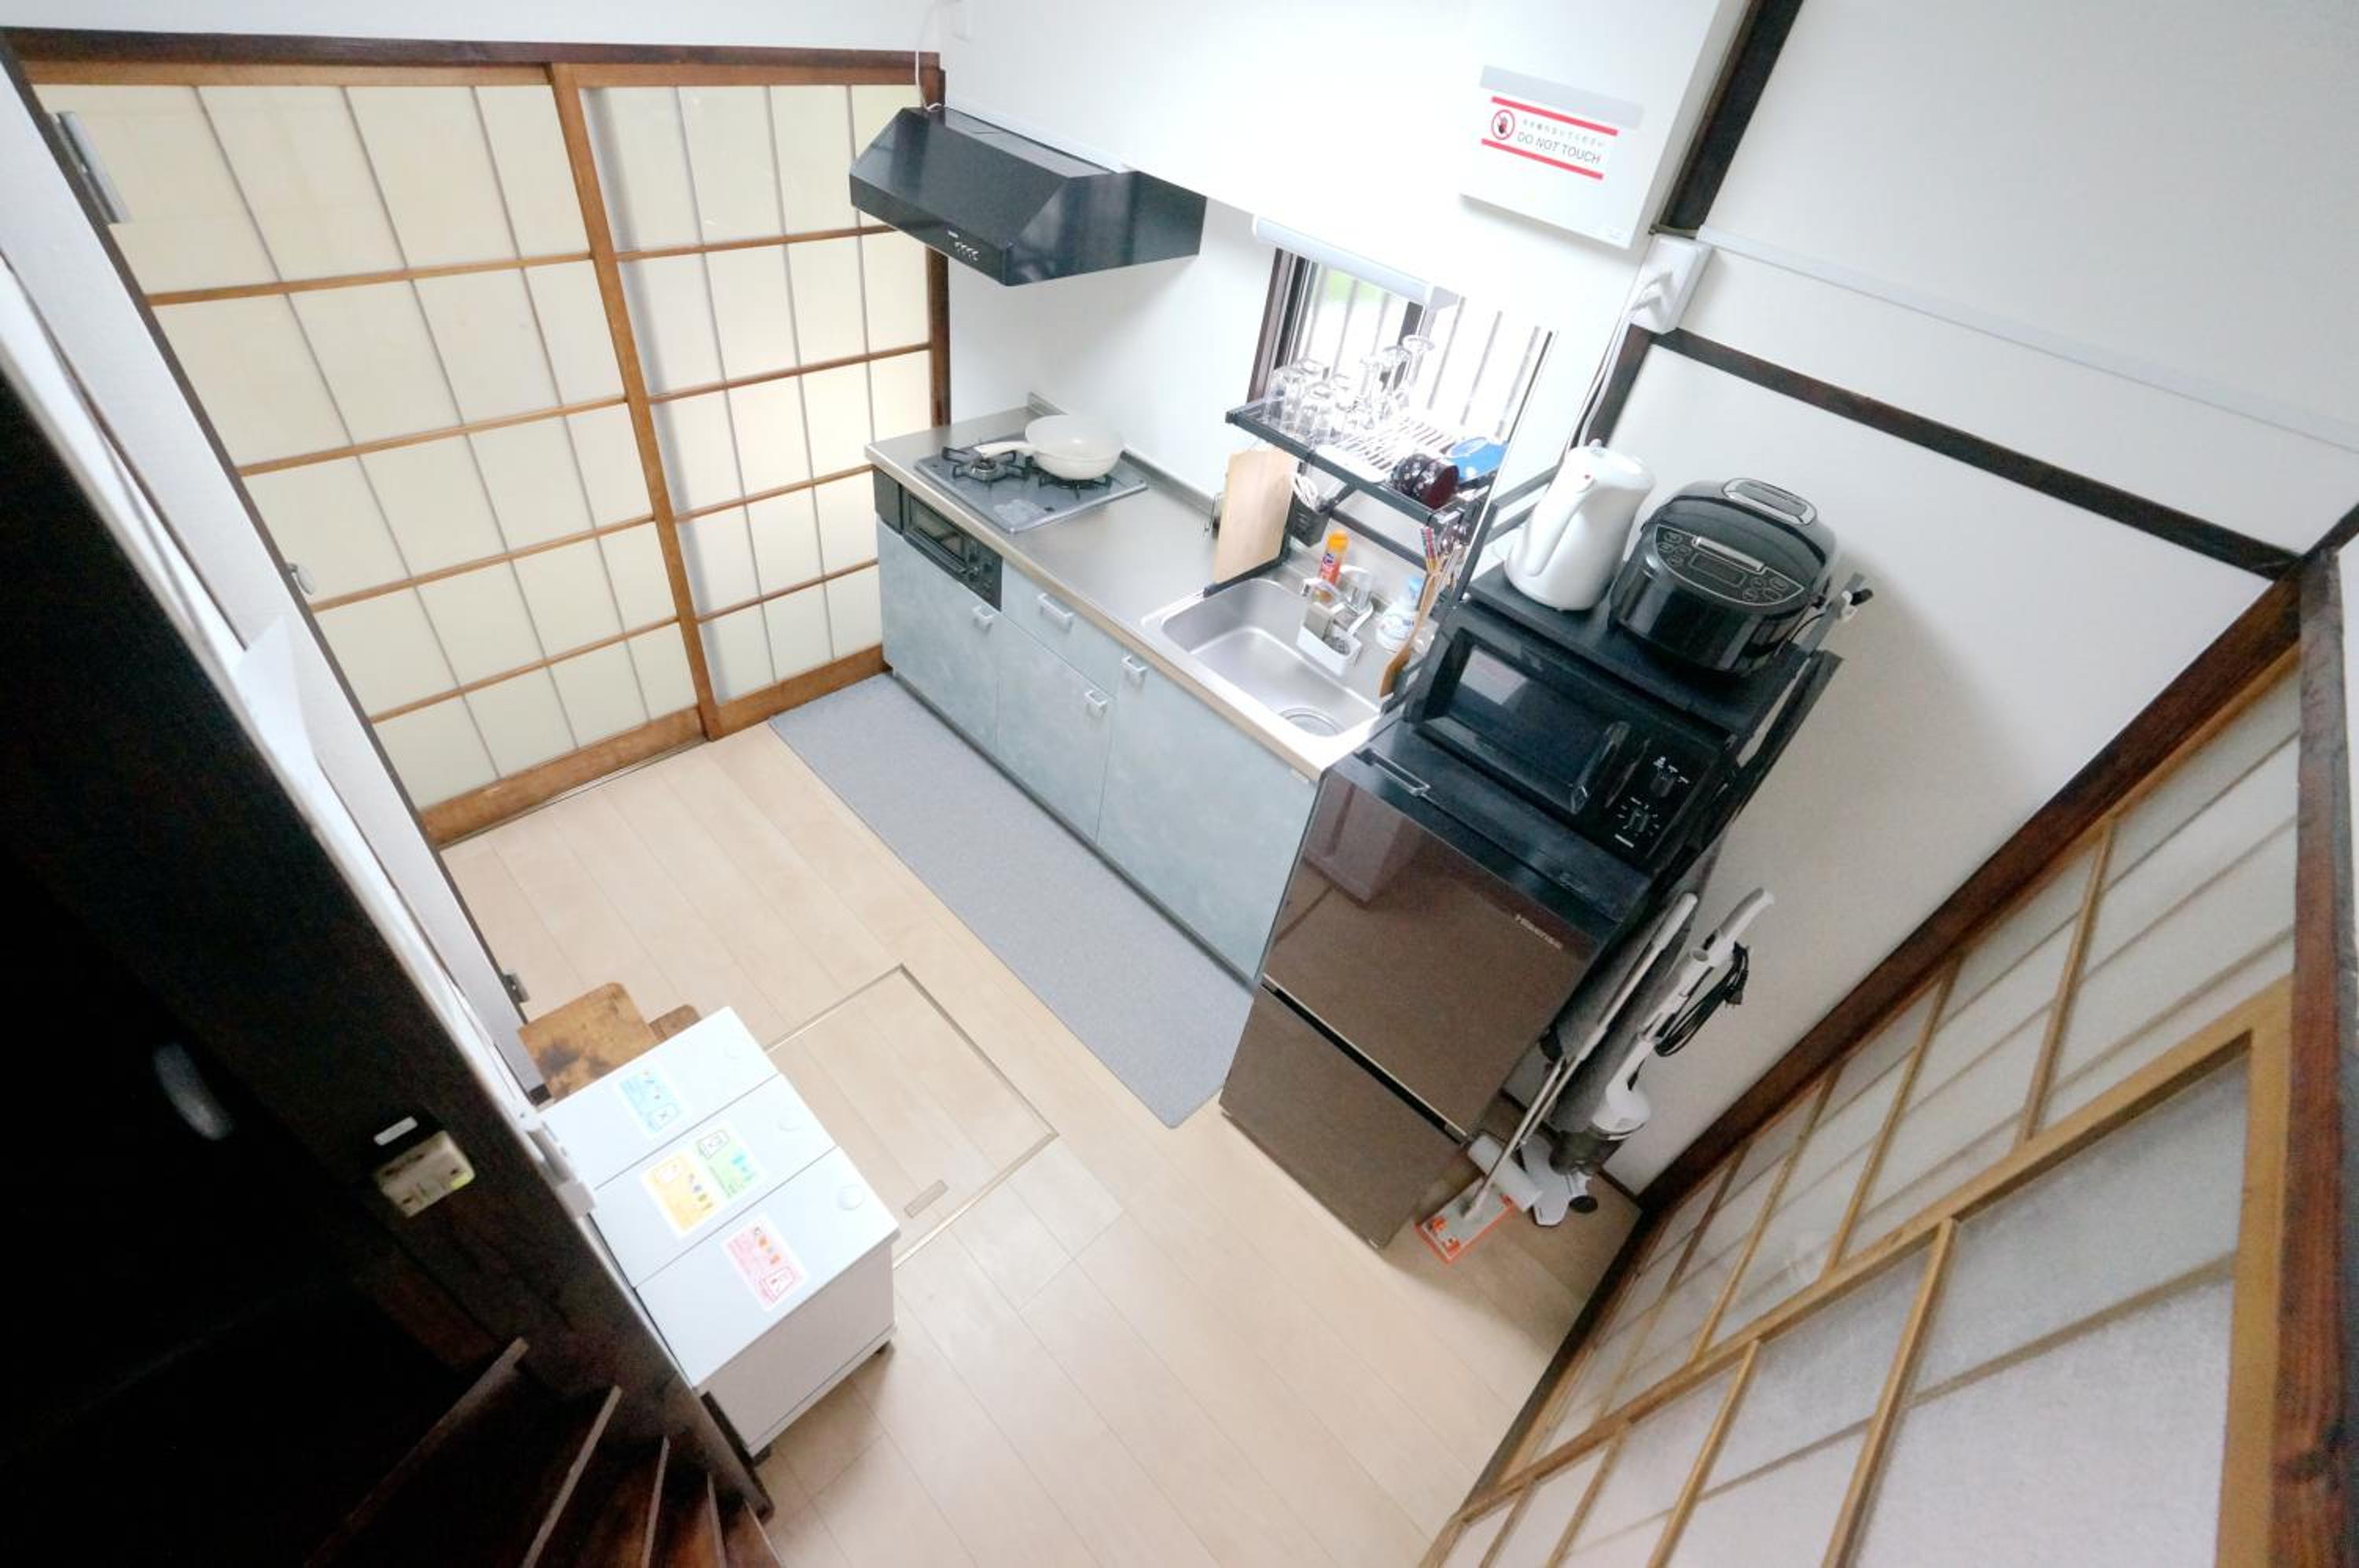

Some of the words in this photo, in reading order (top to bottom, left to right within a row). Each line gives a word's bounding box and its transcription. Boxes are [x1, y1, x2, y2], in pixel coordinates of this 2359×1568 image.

[1517, 131, 1534, 145] DO
[1536, 138, 1560, 152] NOT
[1562, 143, 1602, 164] TOUCH
